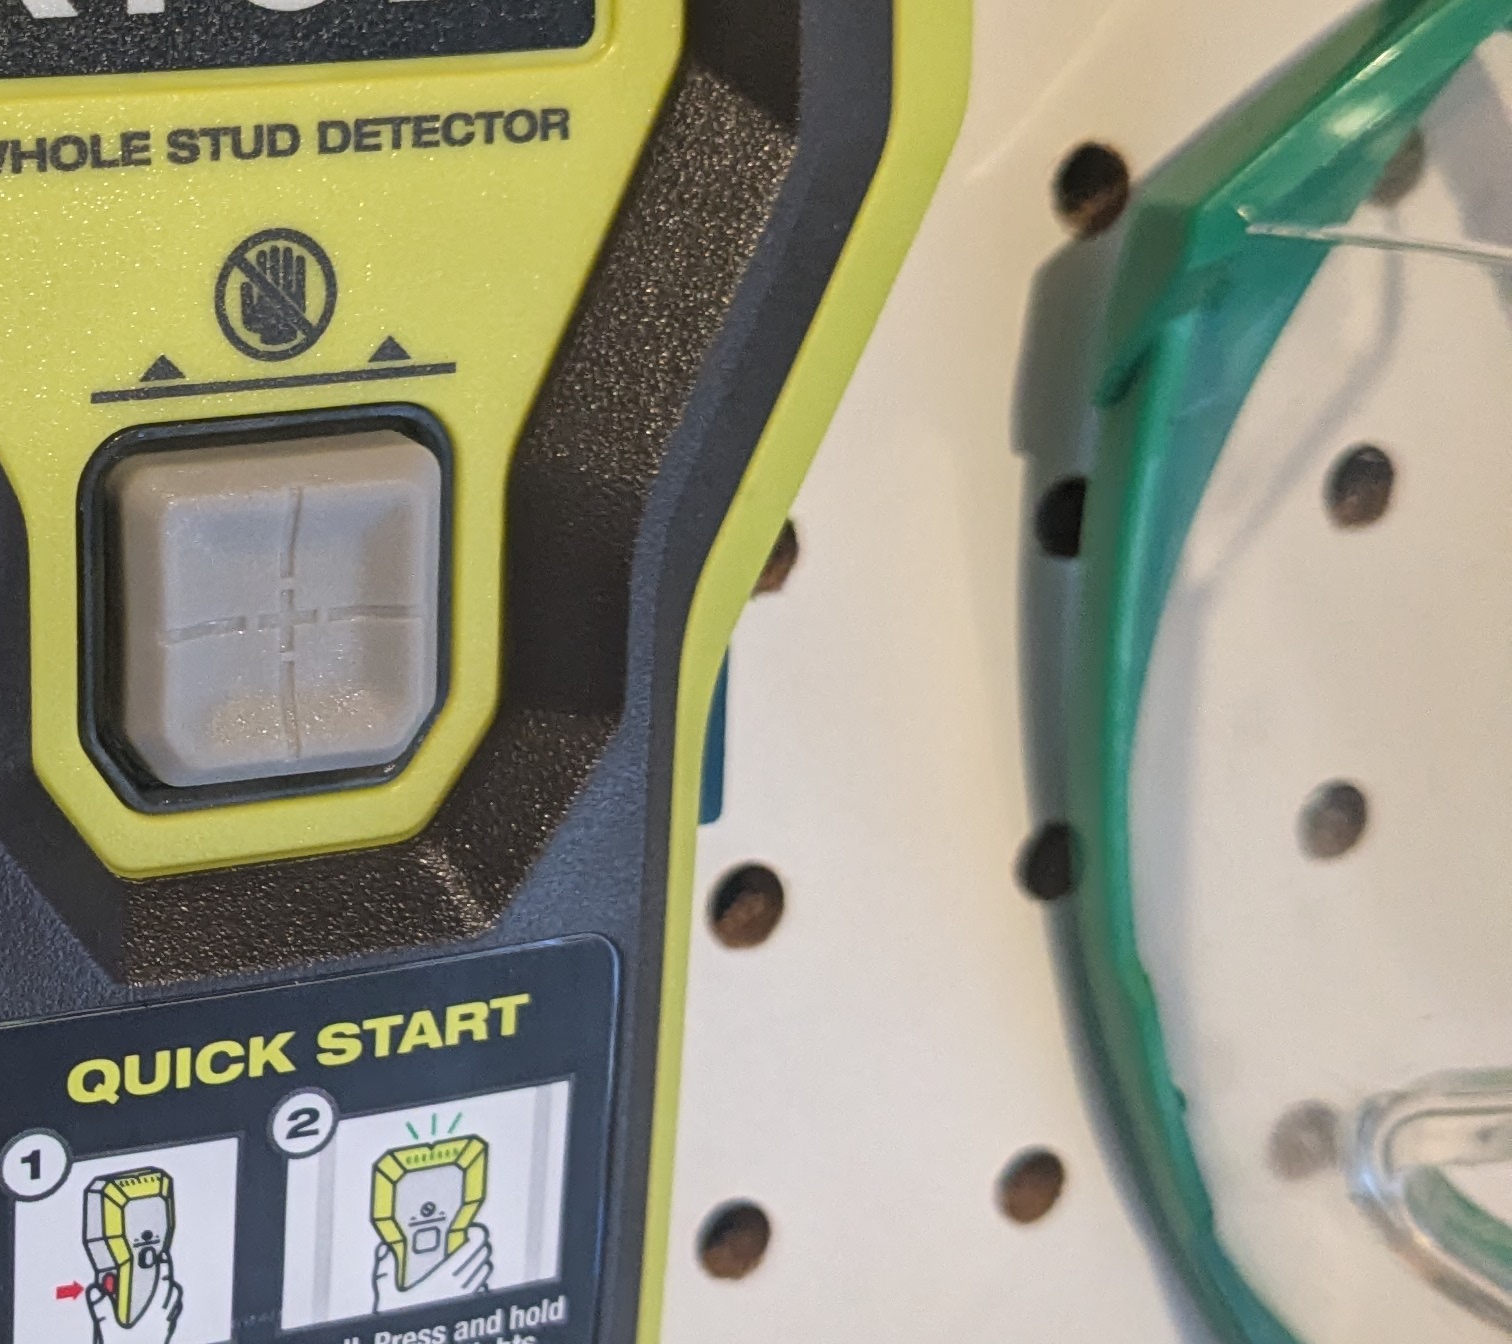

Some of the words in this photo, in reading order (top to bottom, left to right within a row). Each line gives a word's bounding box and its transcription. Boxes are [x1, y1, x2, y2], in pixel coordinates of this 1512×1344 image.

[167, 122, 300, 166] STUD
[317, 107, 570, 156] DETECTOR
[66, 1030, 296, 1105] QUICK
[316, 994, 531, 1067] START
[286, 1107, 320, 1140] 2
[20, 1150, 42, 1180] 1
[454, 1309, 503, 1342] and
[509, 1295, 566, 1330] hold
